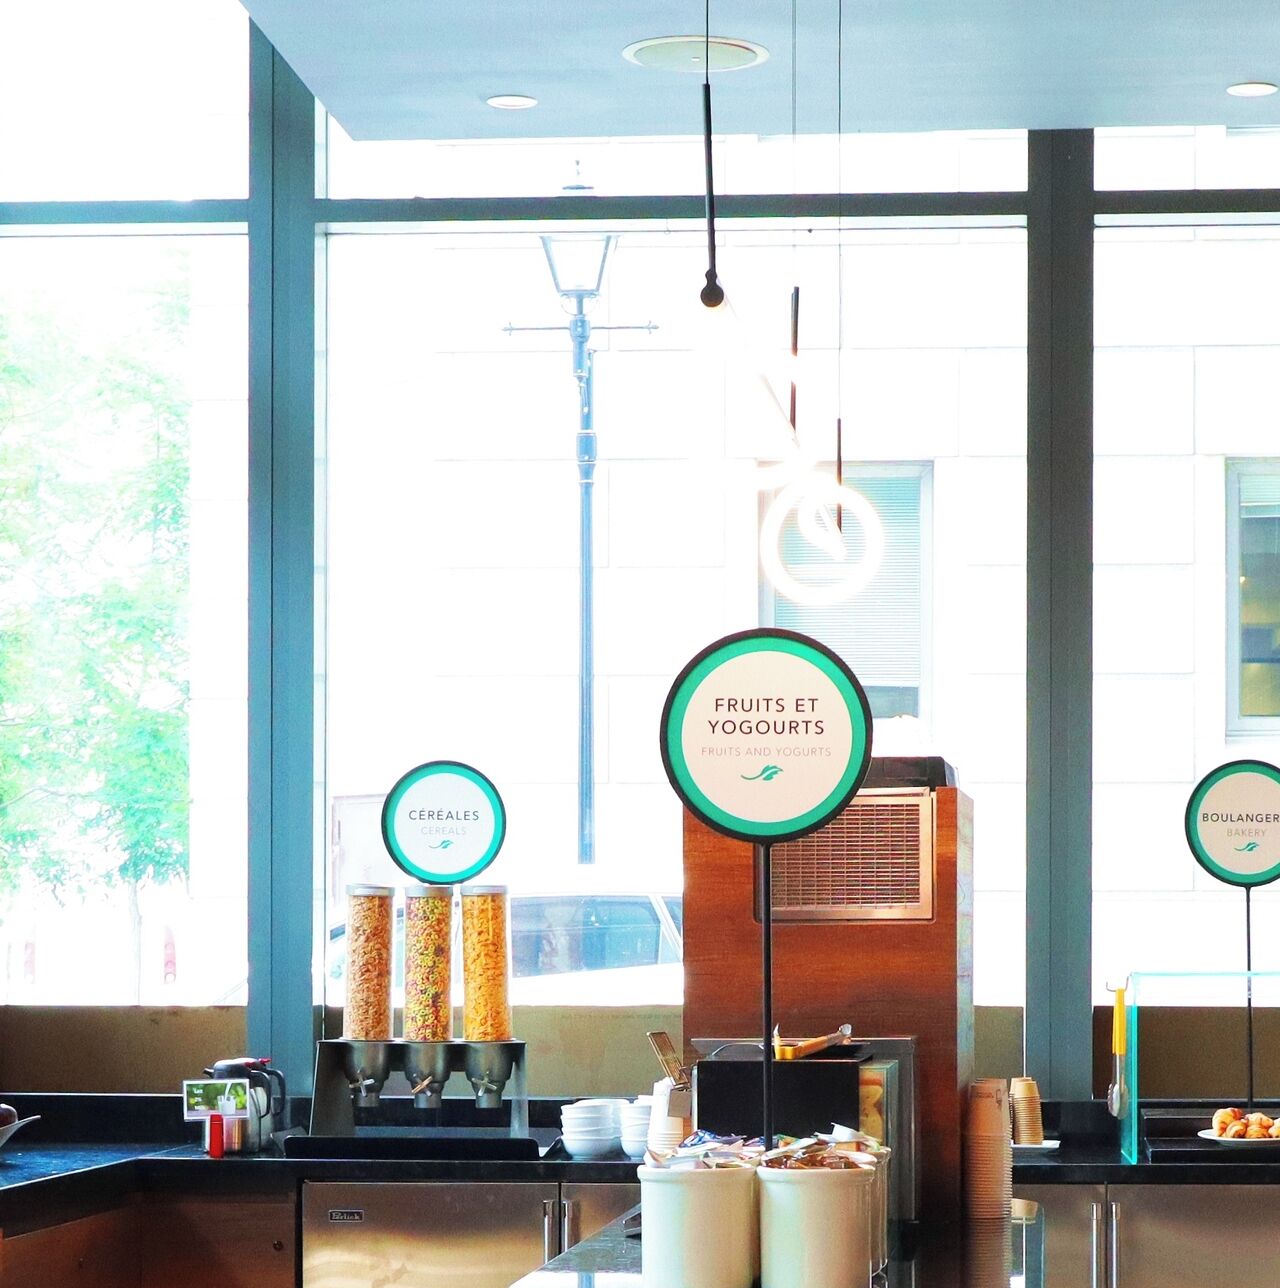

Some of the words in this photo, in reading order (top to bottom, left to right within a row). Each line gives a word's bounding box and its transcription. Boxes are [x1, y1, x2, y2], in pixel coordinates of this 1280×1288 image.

[714, 698, 785, 713] FRUITS
[795, 698, 819, 713] ET
[708, 720, 825, 735] YOGOURTS
[701, 746, 741, 757] FRUITS
[745, 746, 772, 757] AND
[776, 746, 832, 757] YOGURTS
[408, 808, 480, 821] CÉRÉALES
[420, 826, 467, 836] CEREALS
[1226, 828, 1267, 837] BAKERY
